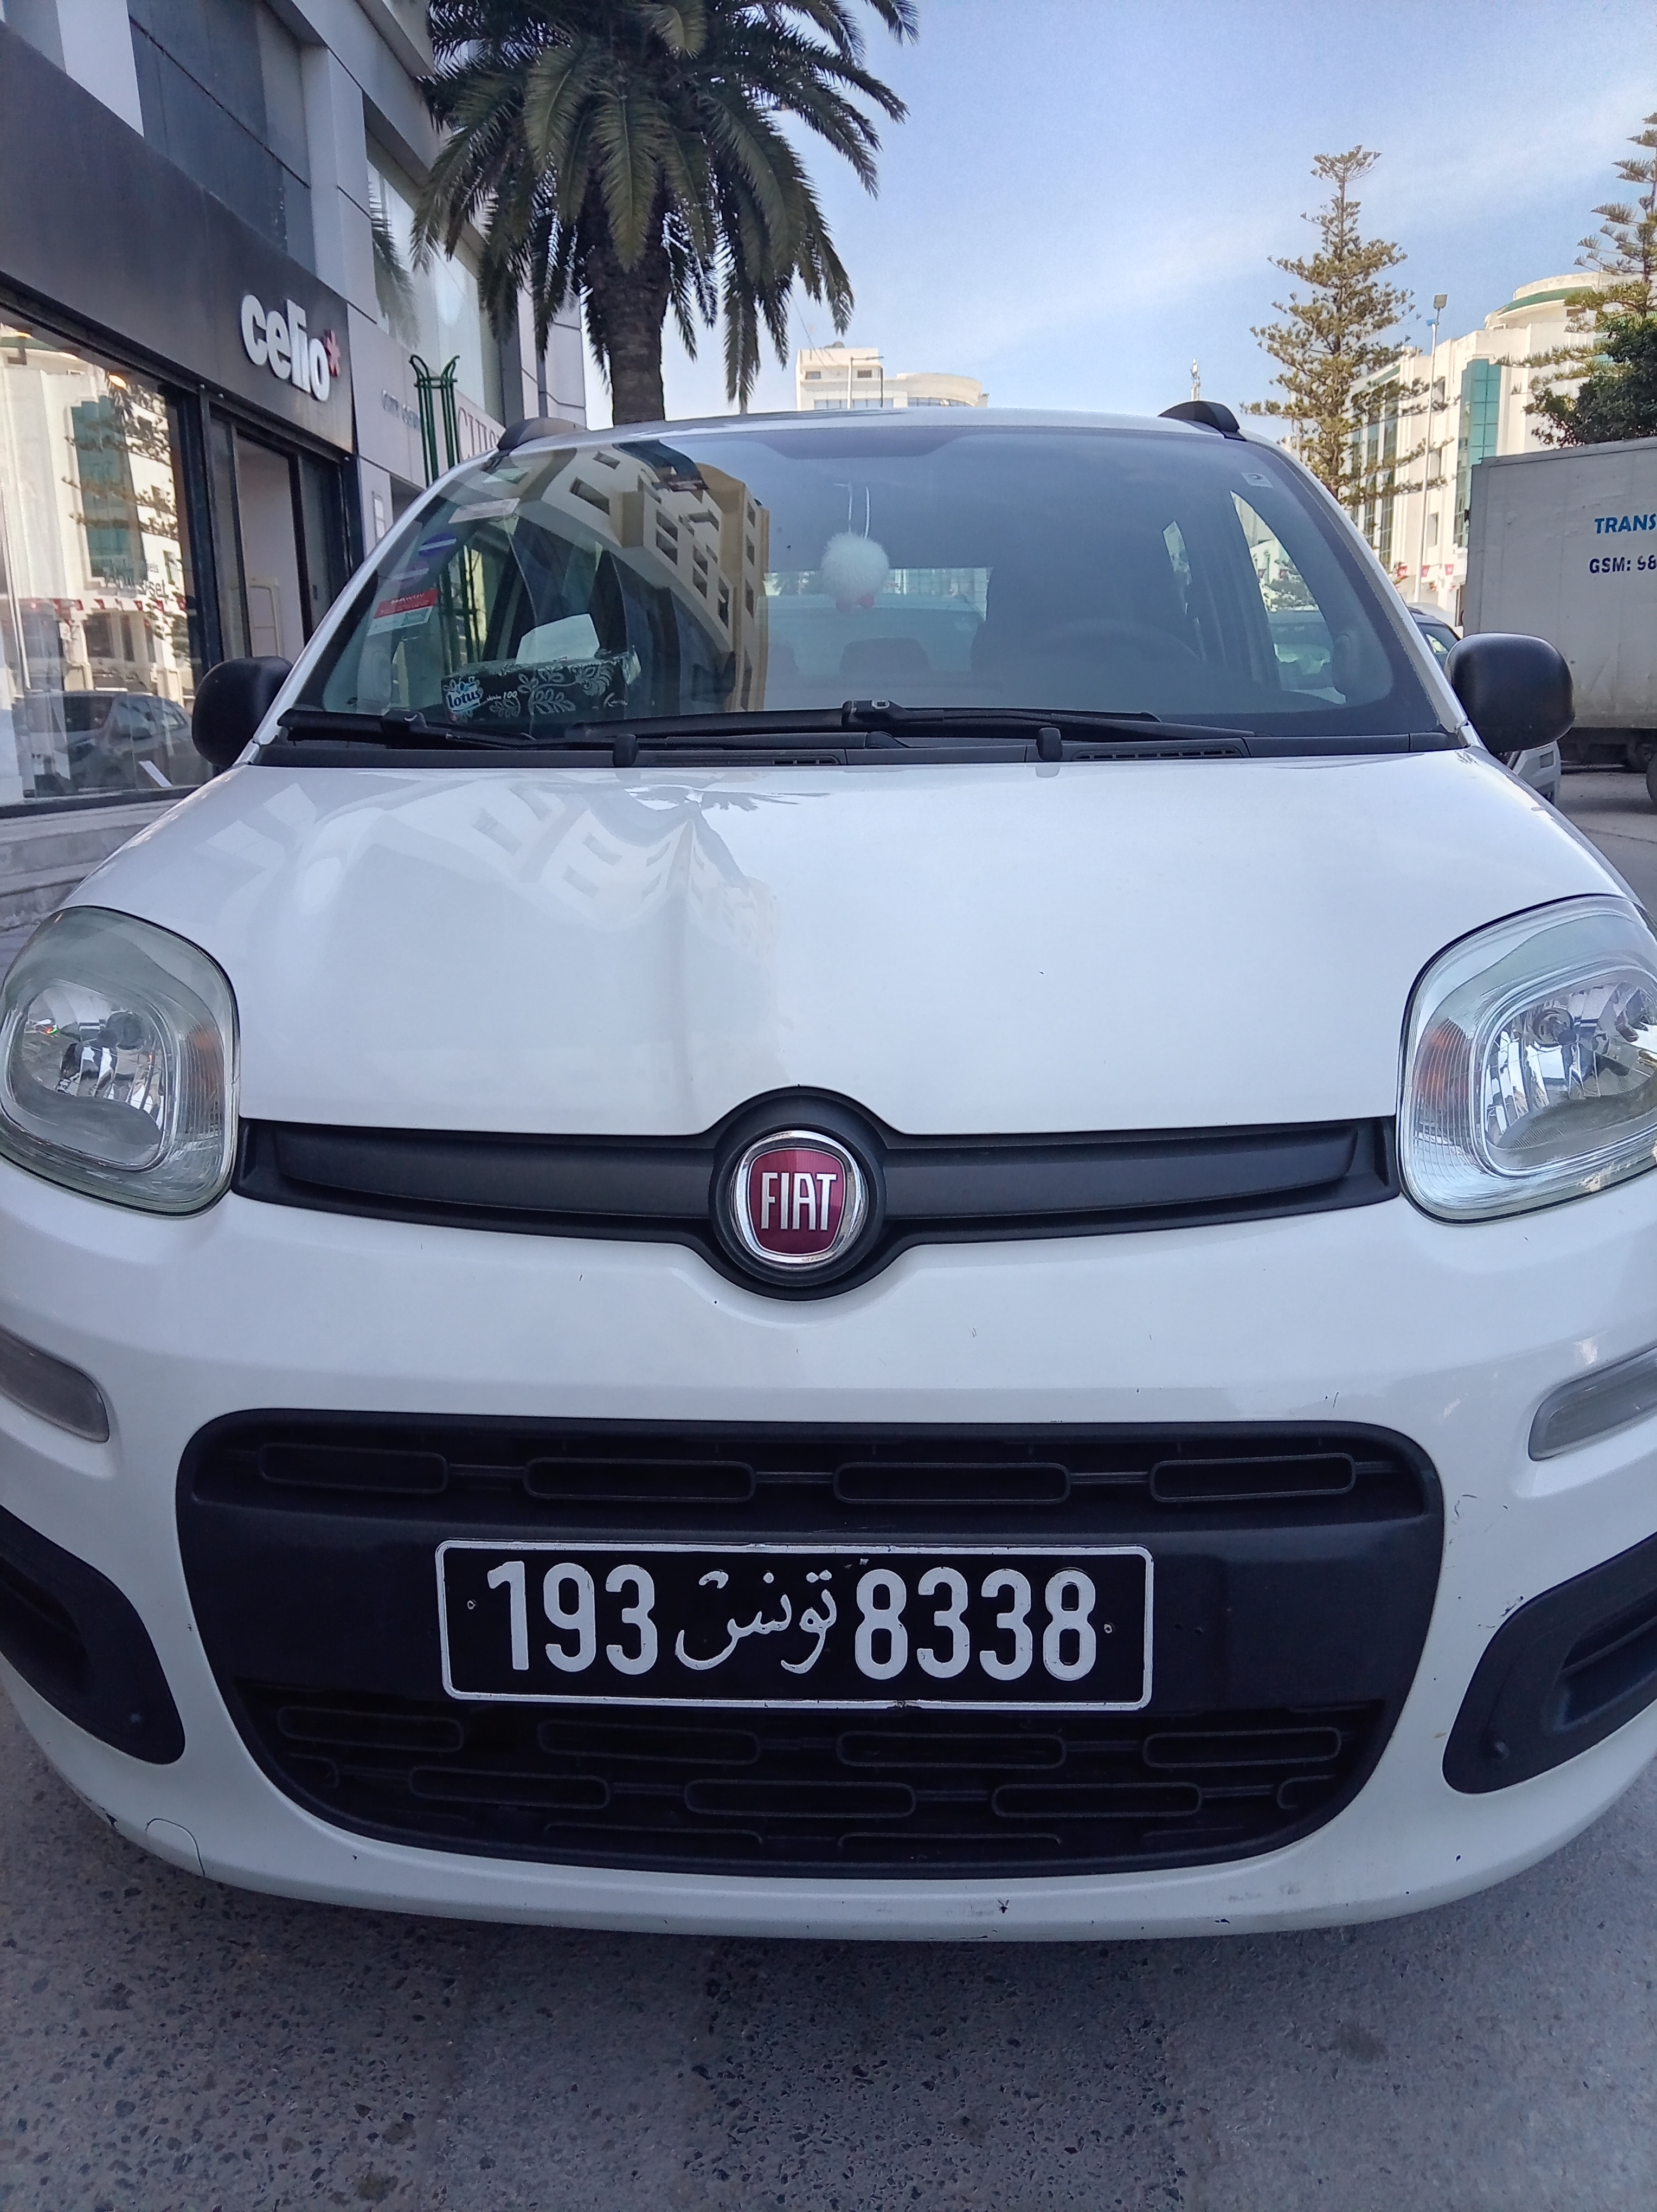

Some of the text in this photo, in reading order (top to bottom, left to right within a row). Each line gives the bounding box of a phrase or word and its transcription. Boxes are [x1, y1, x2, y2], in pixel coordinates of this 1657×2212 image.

[1594, 513, 1656, 534] TRANS
[1589, 556, 1631, 573] GSM:
[447, 690, 481, 708] lotus
[503, 690, 518, 699] 100
[761, 1172, 837, 1231] FIAT
[486, 1560, 1096, 1681] 193 تونس 8338
